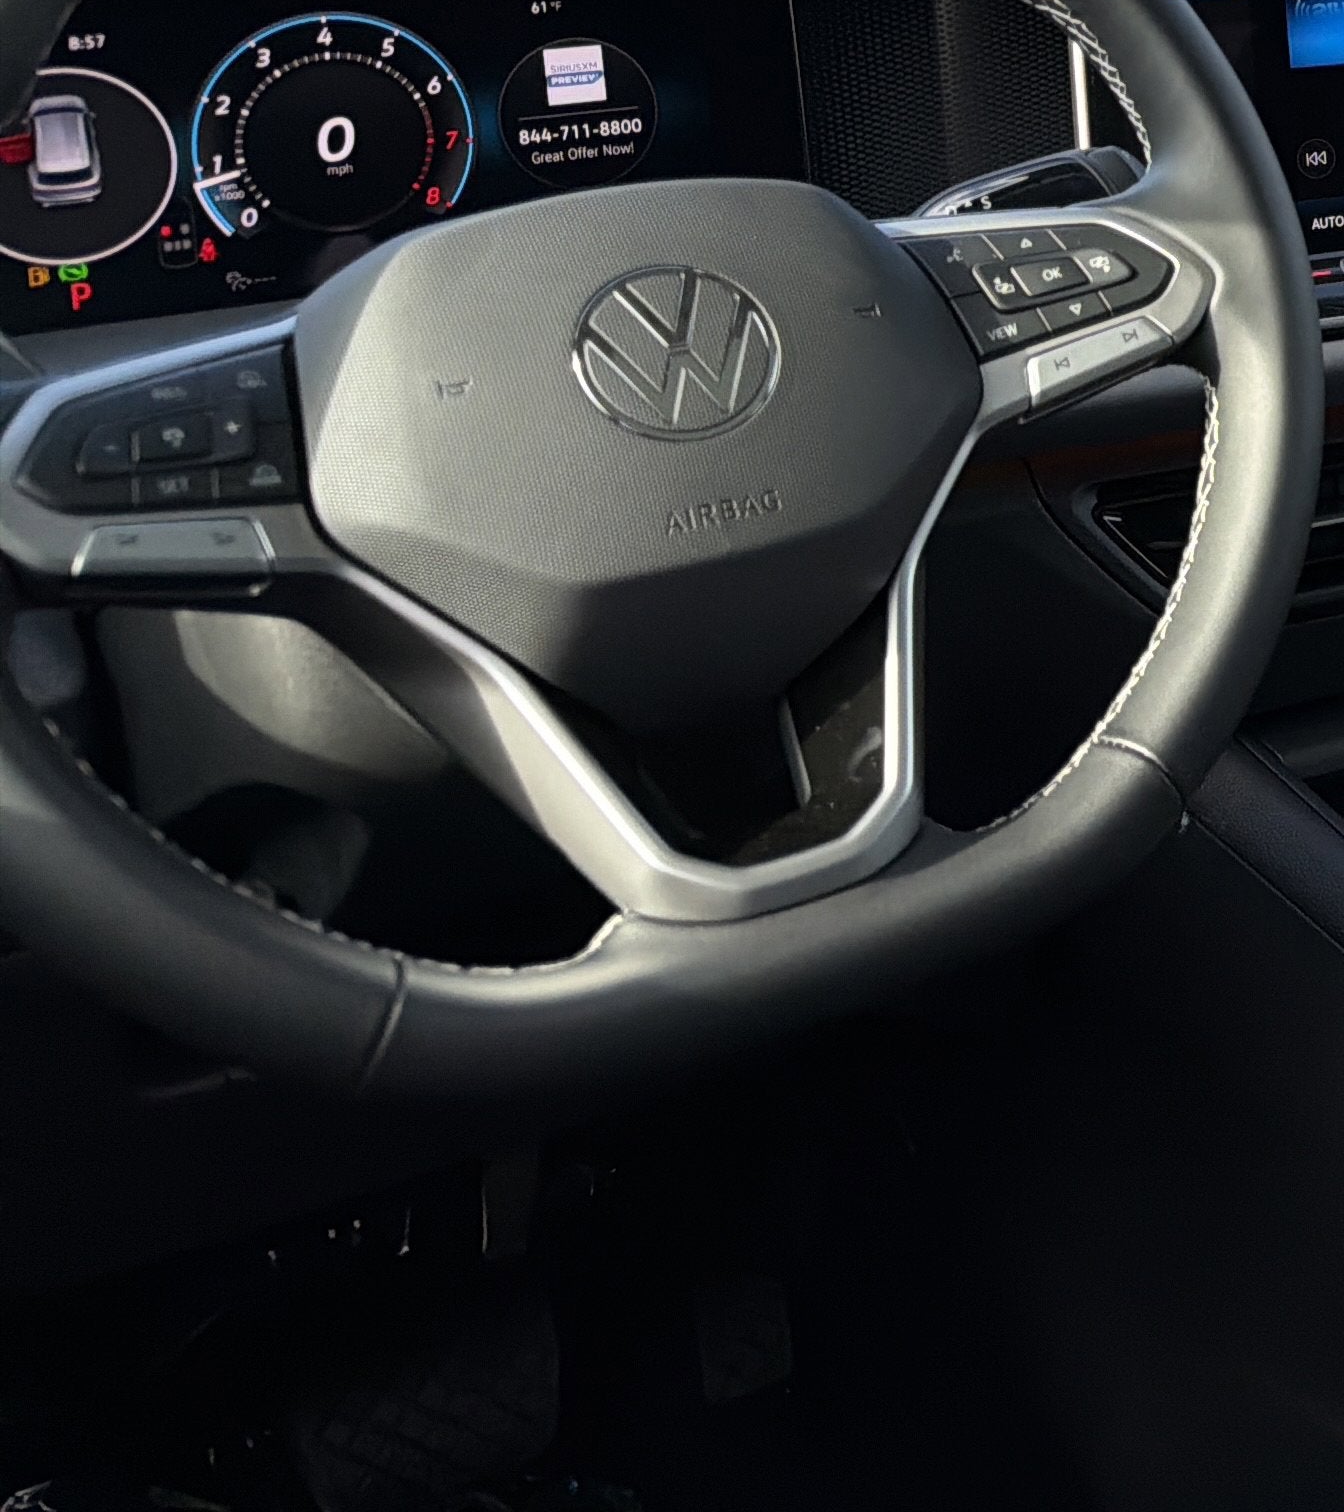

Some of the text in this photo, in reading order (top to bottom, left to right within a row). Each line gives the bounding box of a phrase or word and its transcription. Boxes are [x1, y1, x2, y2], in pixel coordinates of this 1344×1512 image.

[531, 1, 547, 14] 61
[67, 33, 107, 52] 8:57
[316, 26, 334, 46] 4
[380, 35, 396, 57] 5
[255, 47, 272, 68] 3
[550, 61, 598, 74] SIRIUSXM
[426, 75, 442, 96] 6
[215, 94, 232, 116] 2
[317, 116, 356, 163] 0
[445, 130, 460, 150] 7
[518, 118, 642, 145] 844-711-8800
[531, 140, 635, 165] Great Offer Now!
[212, 154, 223, 175] 1
[326, 163, 354, 177] mph
[426, 187, 441, 206] 8
[980, 195, 992, 210] S
[240, 207, 259, 228] 0
[1311, 213, 1344, 231] AUTO
[1042, 266, 1063, 282] OK
[70, 282, 95, 312] P
[986, 322, 1019, 341] VIEW
[667, 489, 784, 537] AIRBAG
